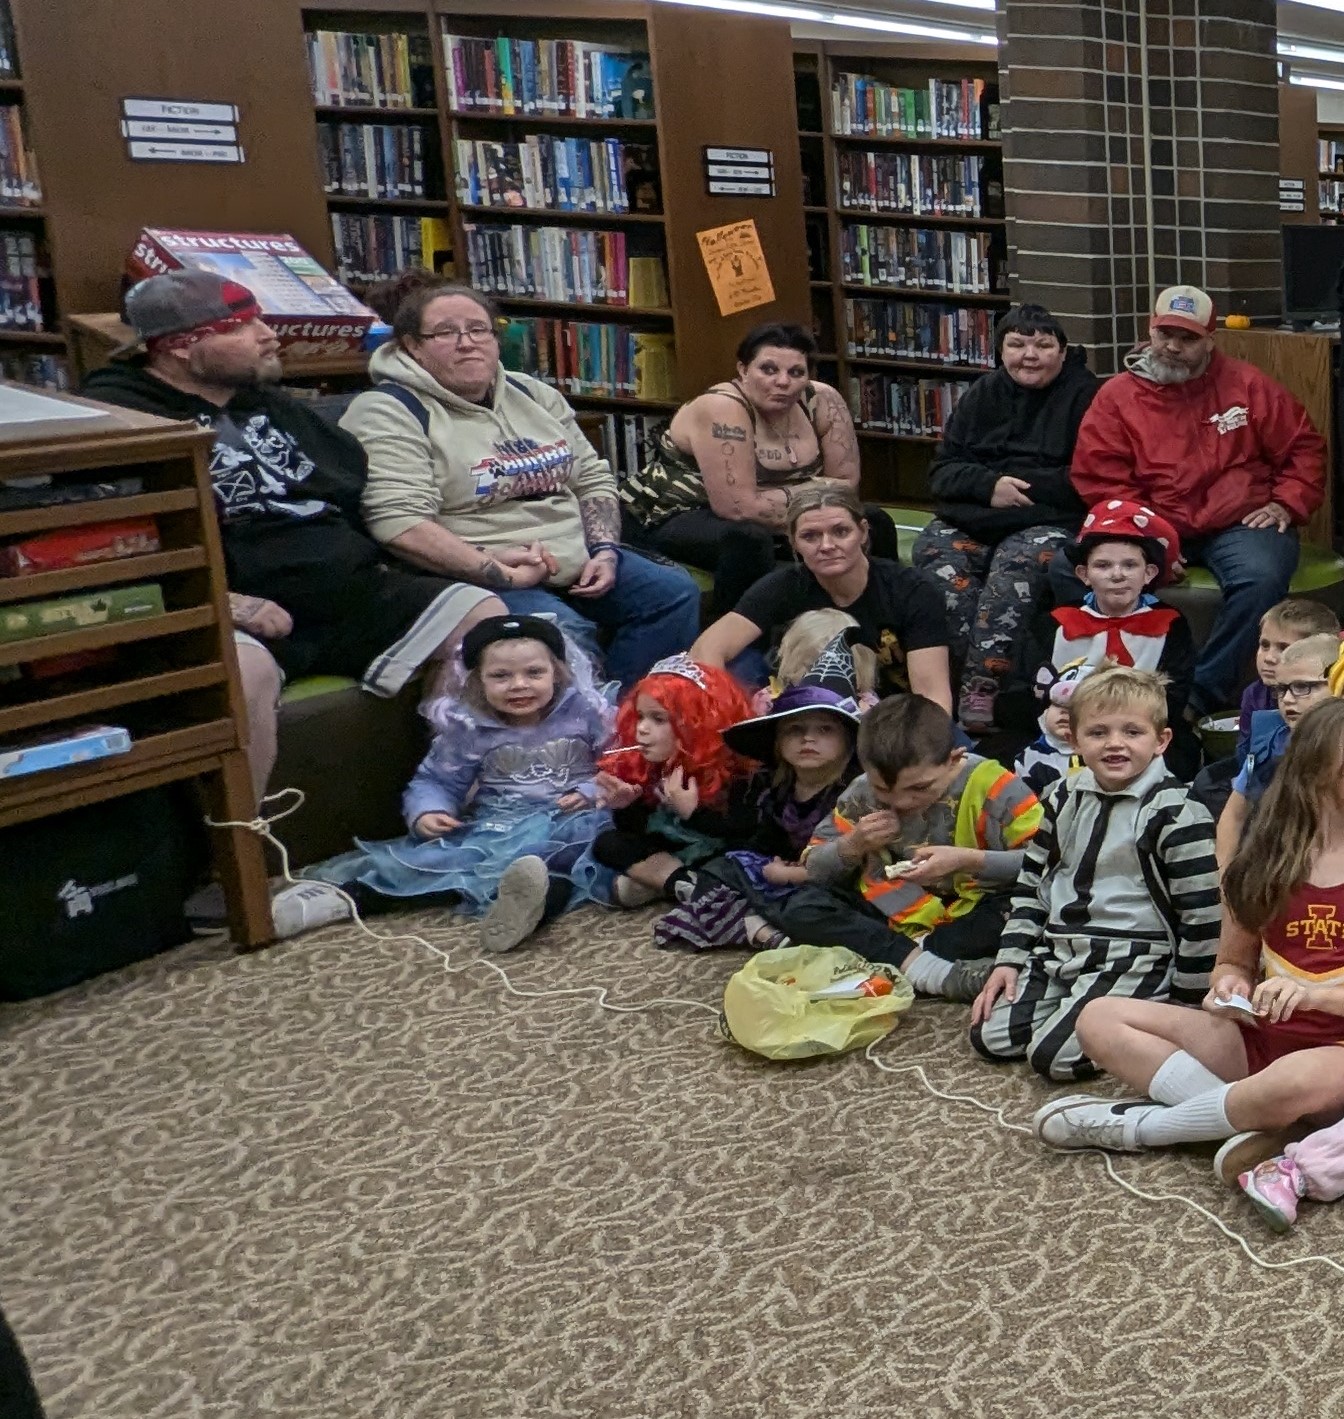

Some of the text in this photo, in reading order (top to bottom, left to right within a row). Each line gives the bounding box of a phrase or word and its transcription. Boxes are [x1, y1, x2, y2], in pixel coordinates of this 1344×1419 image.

[161, 104, 200, 115] FICTION
[160, 233, 302, 253] structures
[270, 322, 366, 338] uctures
